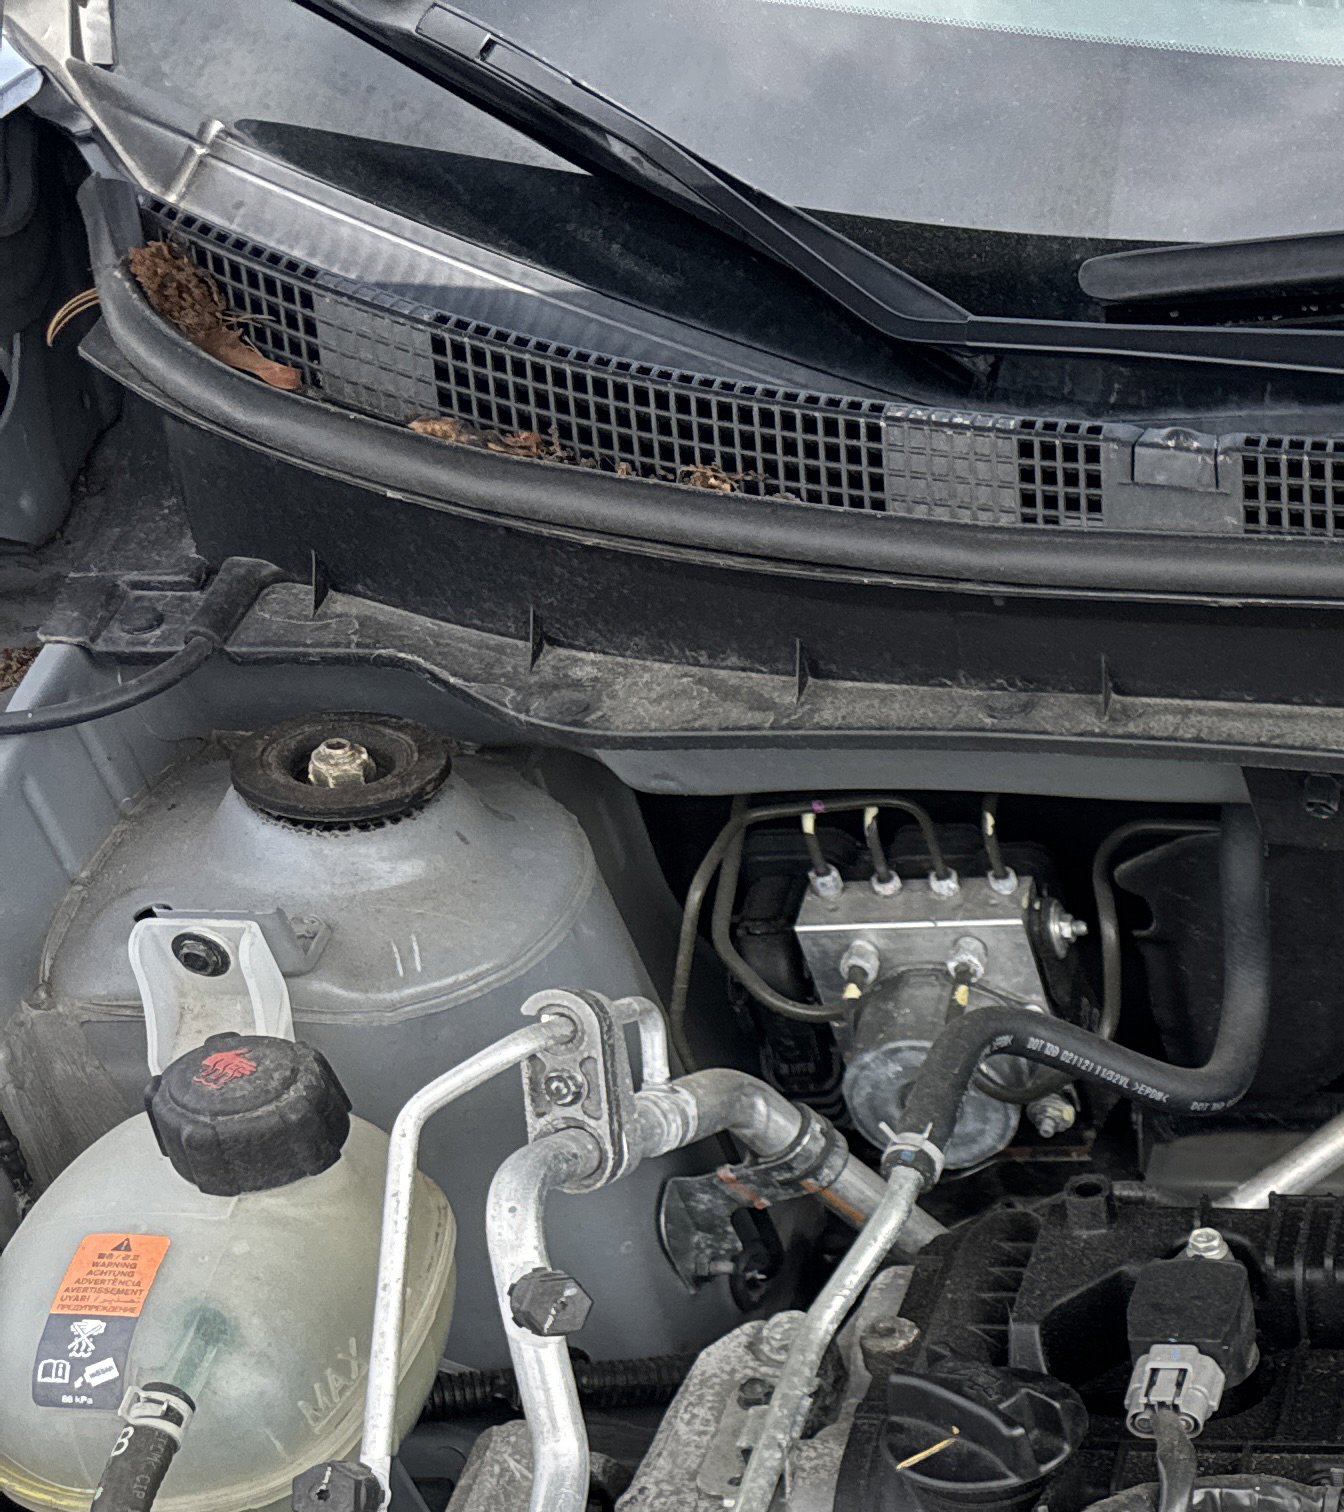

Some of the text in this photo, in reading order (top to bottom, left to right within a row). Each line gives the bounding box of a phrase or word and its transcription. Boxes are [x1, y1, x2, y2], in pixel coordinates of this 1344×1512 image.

[91, 1261, 138, 1270] WARNING
[86, 1269, 136, 1277] ACHTUNG
[64, 1286, 145, 1296] AVERTISSEMENT
[297, 1336, 359, 1426] MAX
[132, 1474, 151, 1500] CIP
